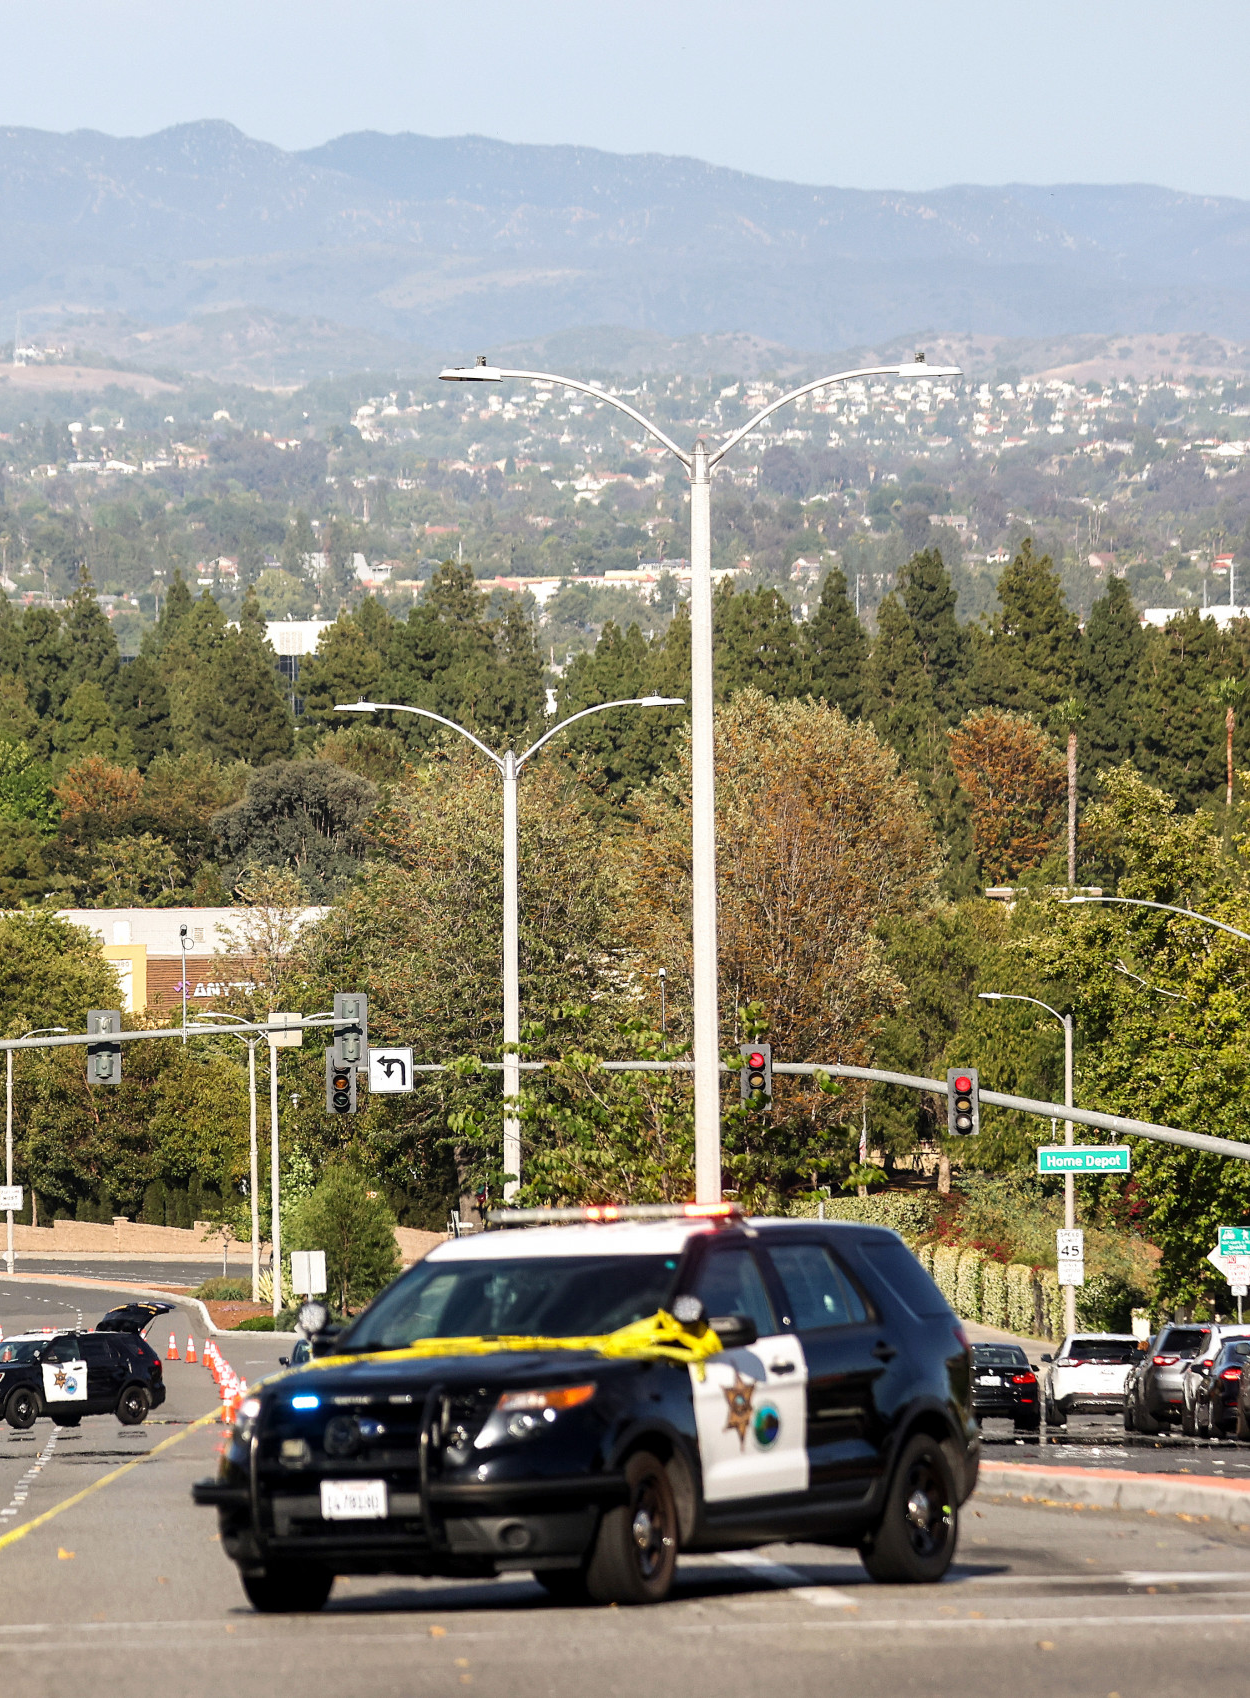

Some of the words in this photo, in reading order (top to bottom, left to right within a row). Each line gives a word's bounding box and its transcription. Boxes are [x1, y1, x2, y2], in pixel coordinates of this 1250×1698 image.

[1046, 1155, 1083, 1168] Home
[1085, 1154, 1121, 1169] Depot
[1061, 1246, 1080, 1257] 45
